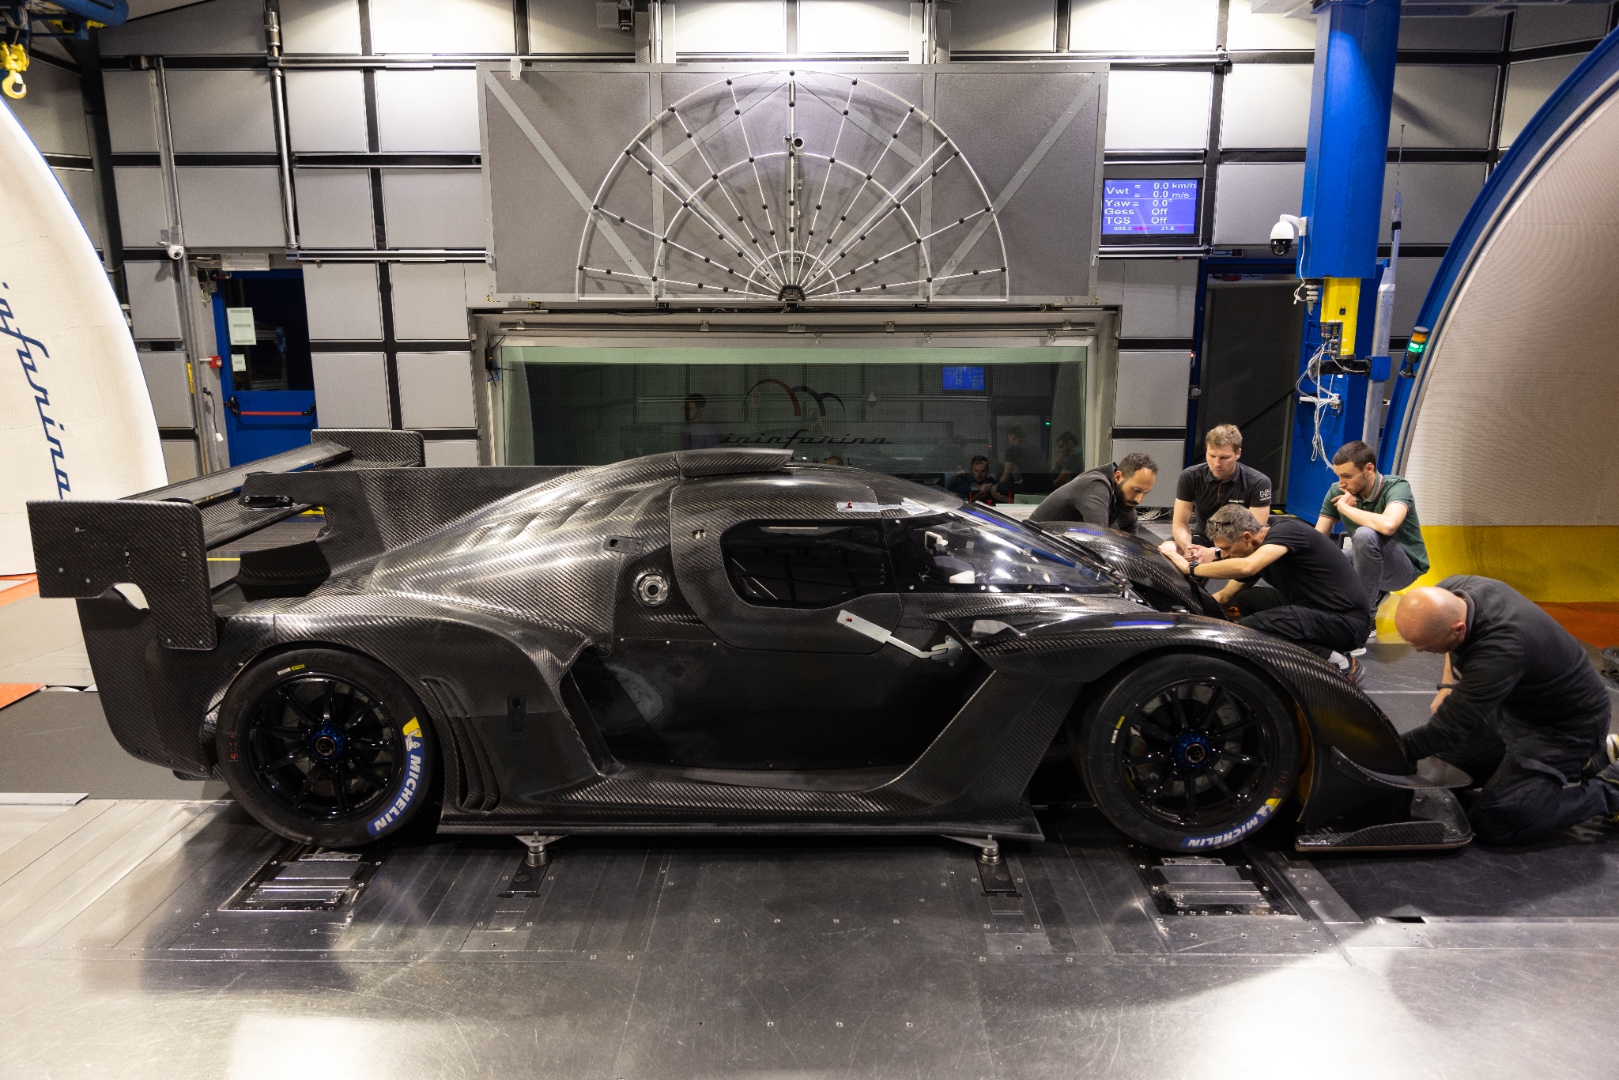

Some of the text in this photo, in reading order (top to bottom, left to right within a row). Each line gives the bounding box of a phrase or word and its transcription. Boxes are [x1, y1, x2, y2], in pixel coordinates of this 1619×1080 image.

[1106, 186, 1129, 195] Vwt
[1153, 182, 1169, 190] 0.0
[1153, 190, 1169, 198] 0.0
[1172, 191, 1190, 199] m/s
[1105, 199, 1130, 207] Yaw
[1151, 208, 1168, 216] Off
[1105, 216, 1168, 225] TGS Off
[374, 754, 422, 832] MICHELIN
[1187, 817, 1259, 847] MICHELIN
